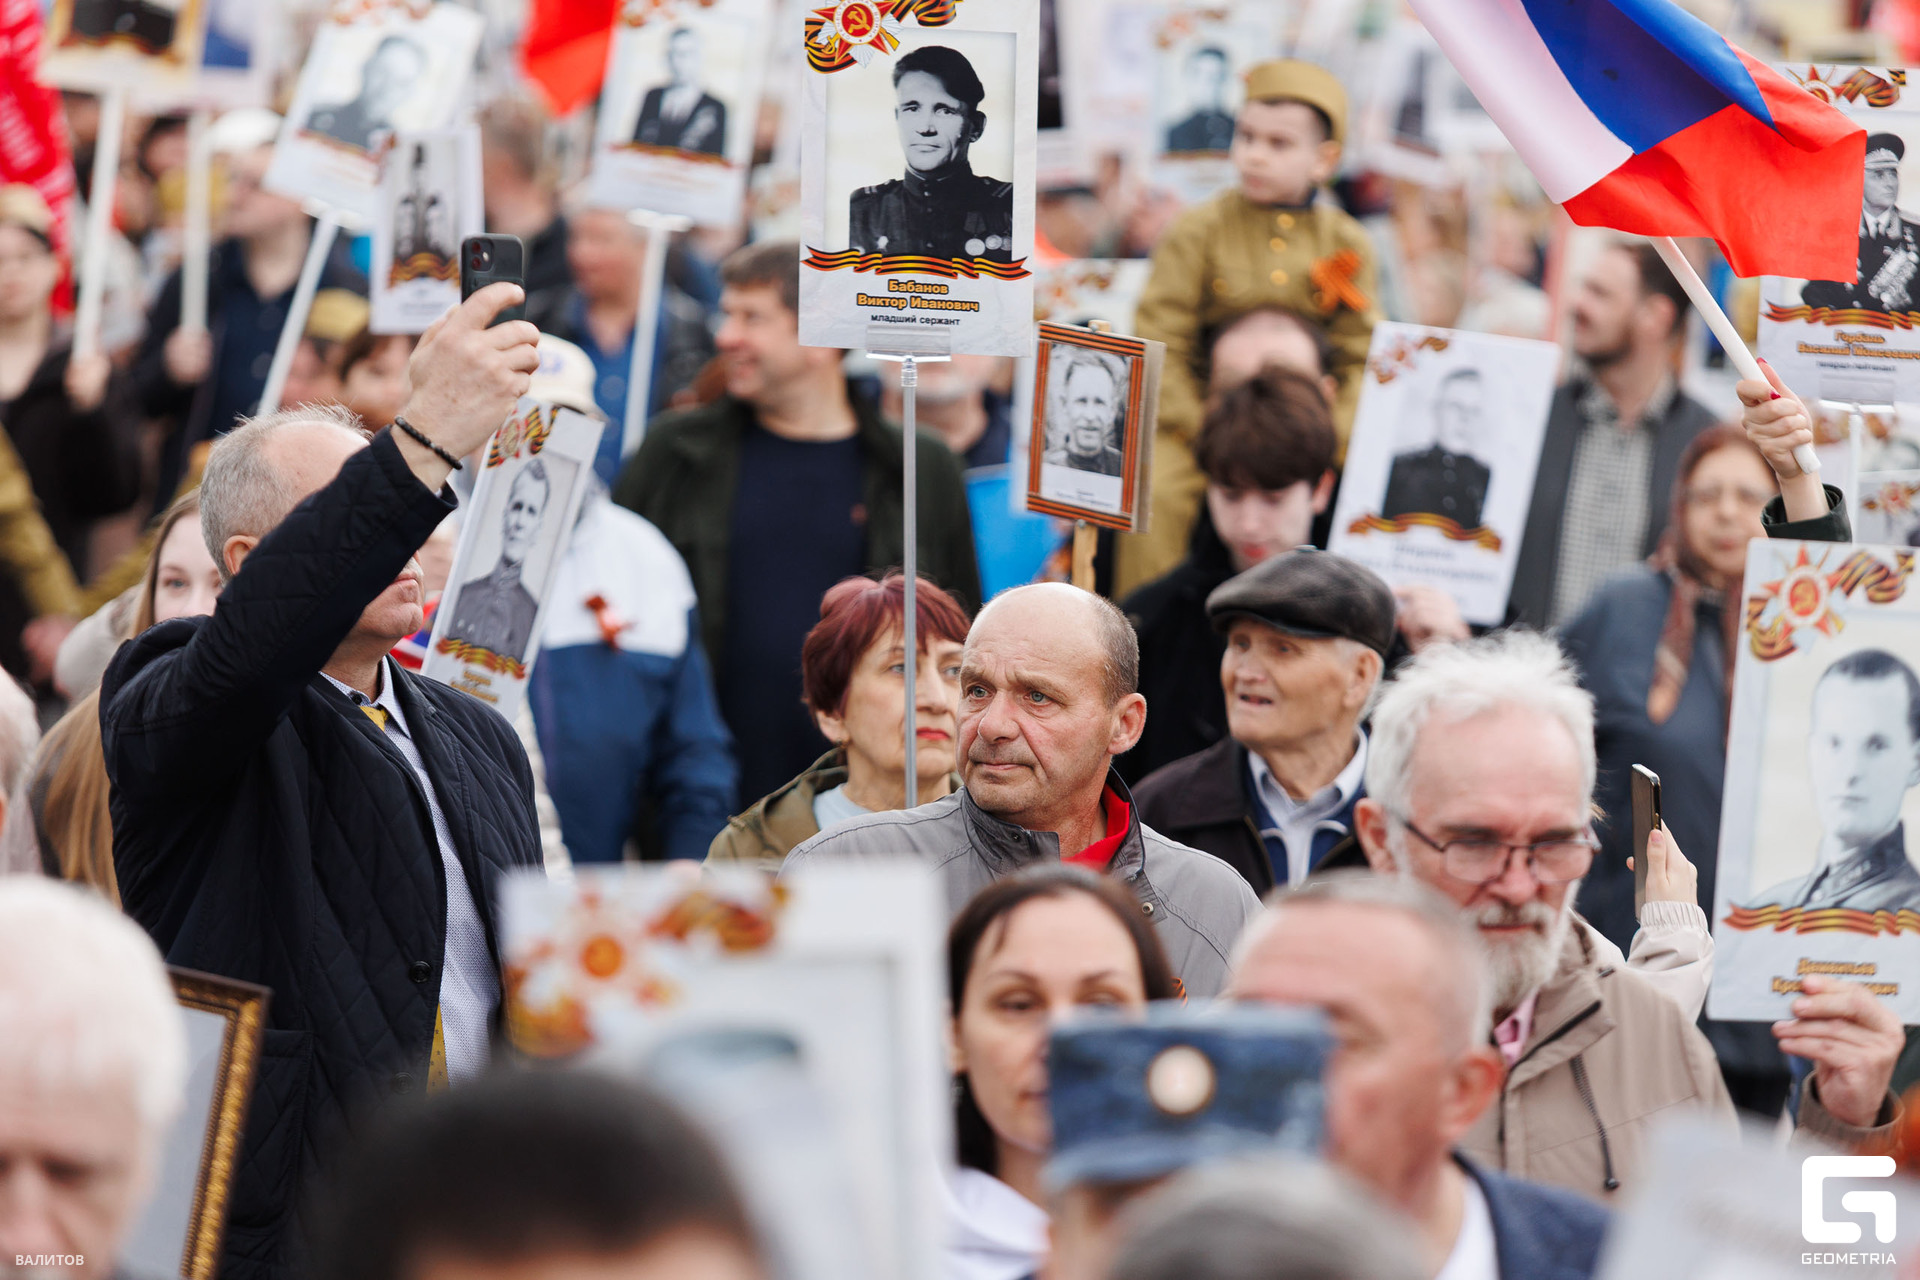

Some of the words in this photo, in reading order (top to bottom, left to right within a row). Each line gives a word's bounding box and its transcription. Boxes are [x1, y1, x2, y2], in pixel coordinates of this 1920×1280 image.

[888, 279, 949, 294] Бабанов
[857, 293, 908, 310] Виктор
[910, 295, 980, 312] Иванович
[871, 314, 916, 323] младший
[920, 316, 960, 325] сержант
